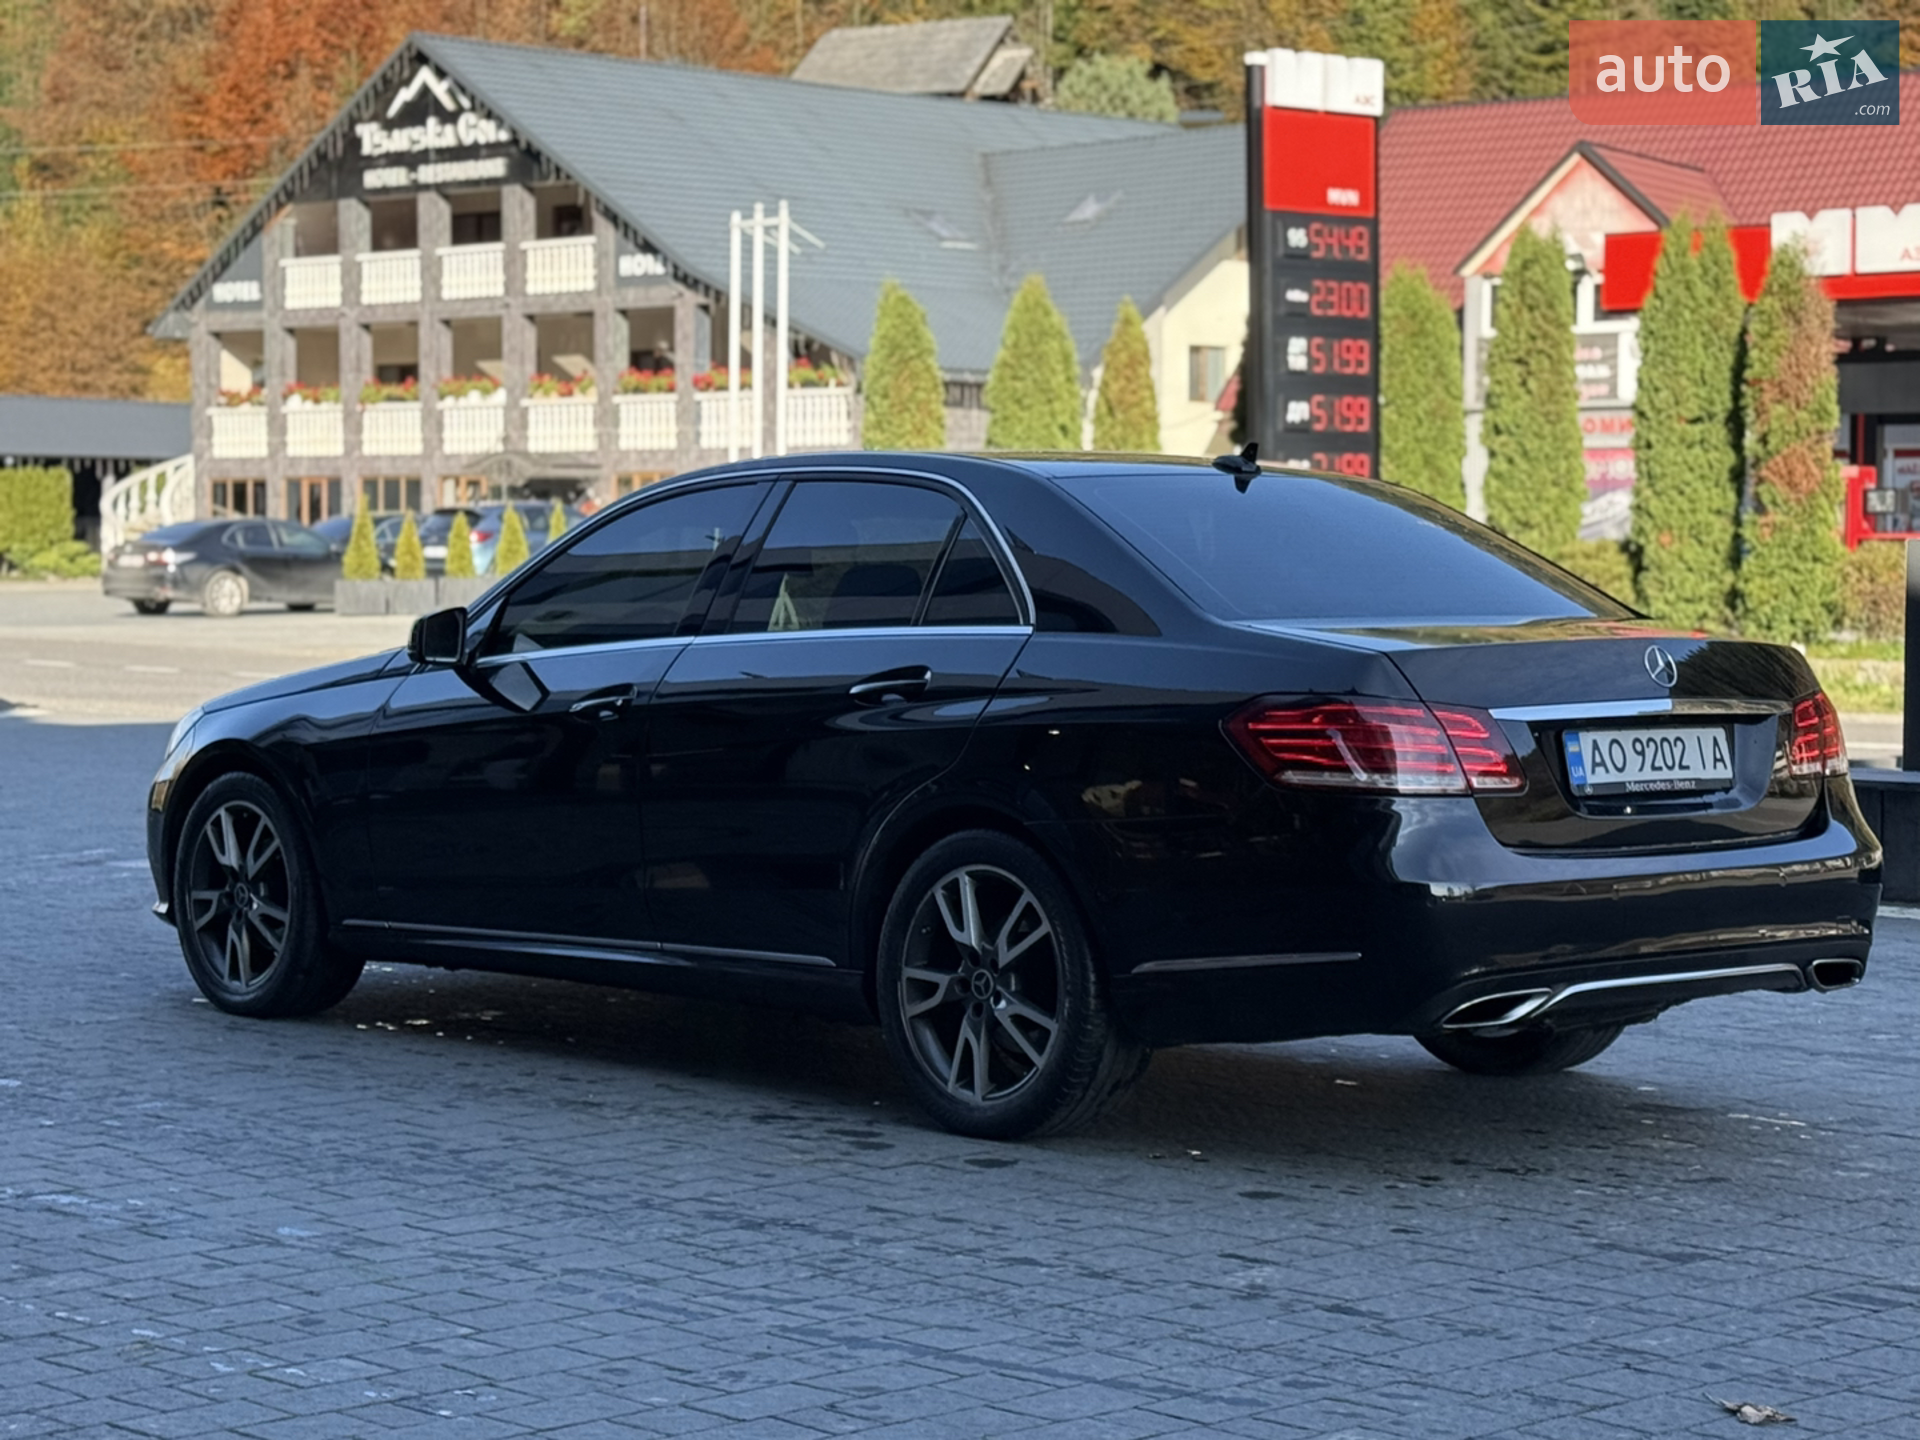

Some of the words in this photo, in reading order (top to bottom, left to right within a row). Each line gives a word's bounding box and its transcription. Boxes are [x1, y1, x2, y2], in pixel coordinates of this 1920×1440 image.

[1591, 738, 1627, 775] AO
[1632, 736, 1690, 772] 9202
[1697, 735, 1728, 770] IA
[1572, 766, 1585, 777] UA
[1625, 780, 1697, 793] Mercedes-Benz
